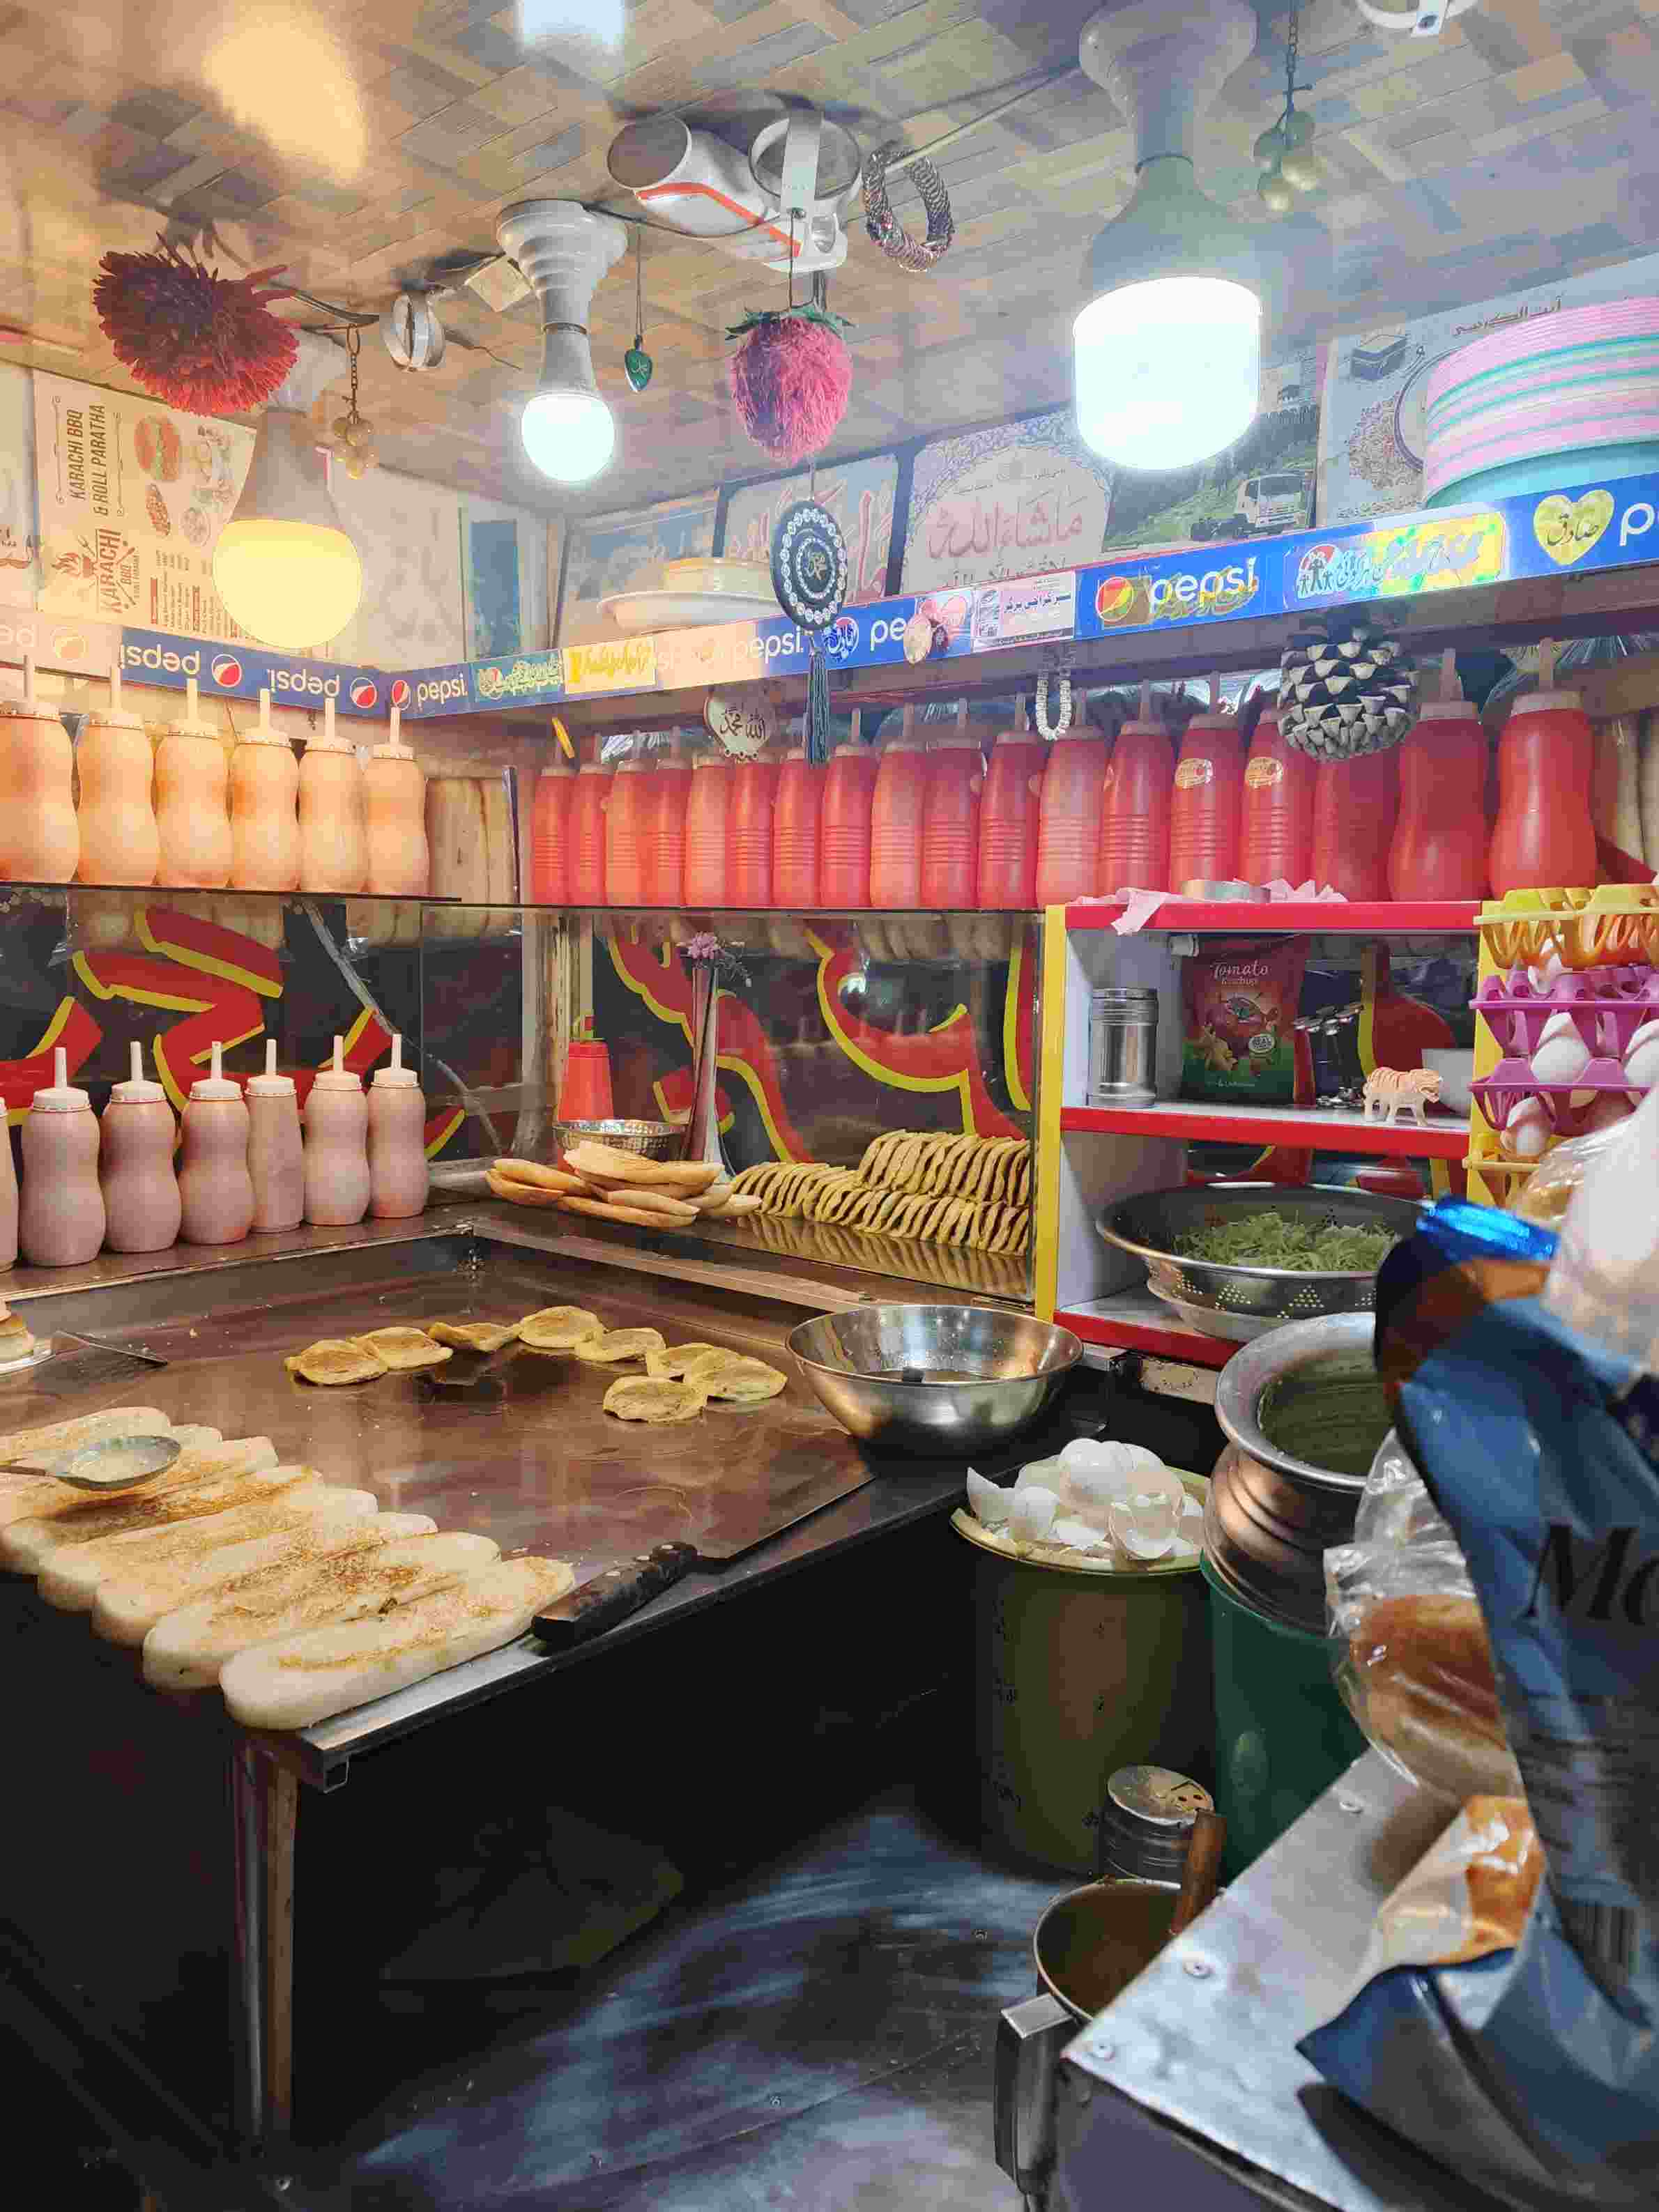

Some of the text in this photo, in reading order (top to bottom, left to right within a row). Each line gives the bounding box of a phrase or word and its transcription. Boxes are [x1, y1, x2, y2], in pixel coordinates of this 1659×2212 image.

[89, 404, 107, 467] PARATHA
[67, 440, 86, 500] KARACHI
[91, 470, 109, 504] ROLL
[1619, 502, 1659, 547] p
[98, 528, 122, 613] KARACHI
[118, 644, 201, 675] pepsi
[269, 669, 341, 698] pepsi
[417, 673, 468, 709] pepsi
[1209, 959, 1271, 982] Tomato
